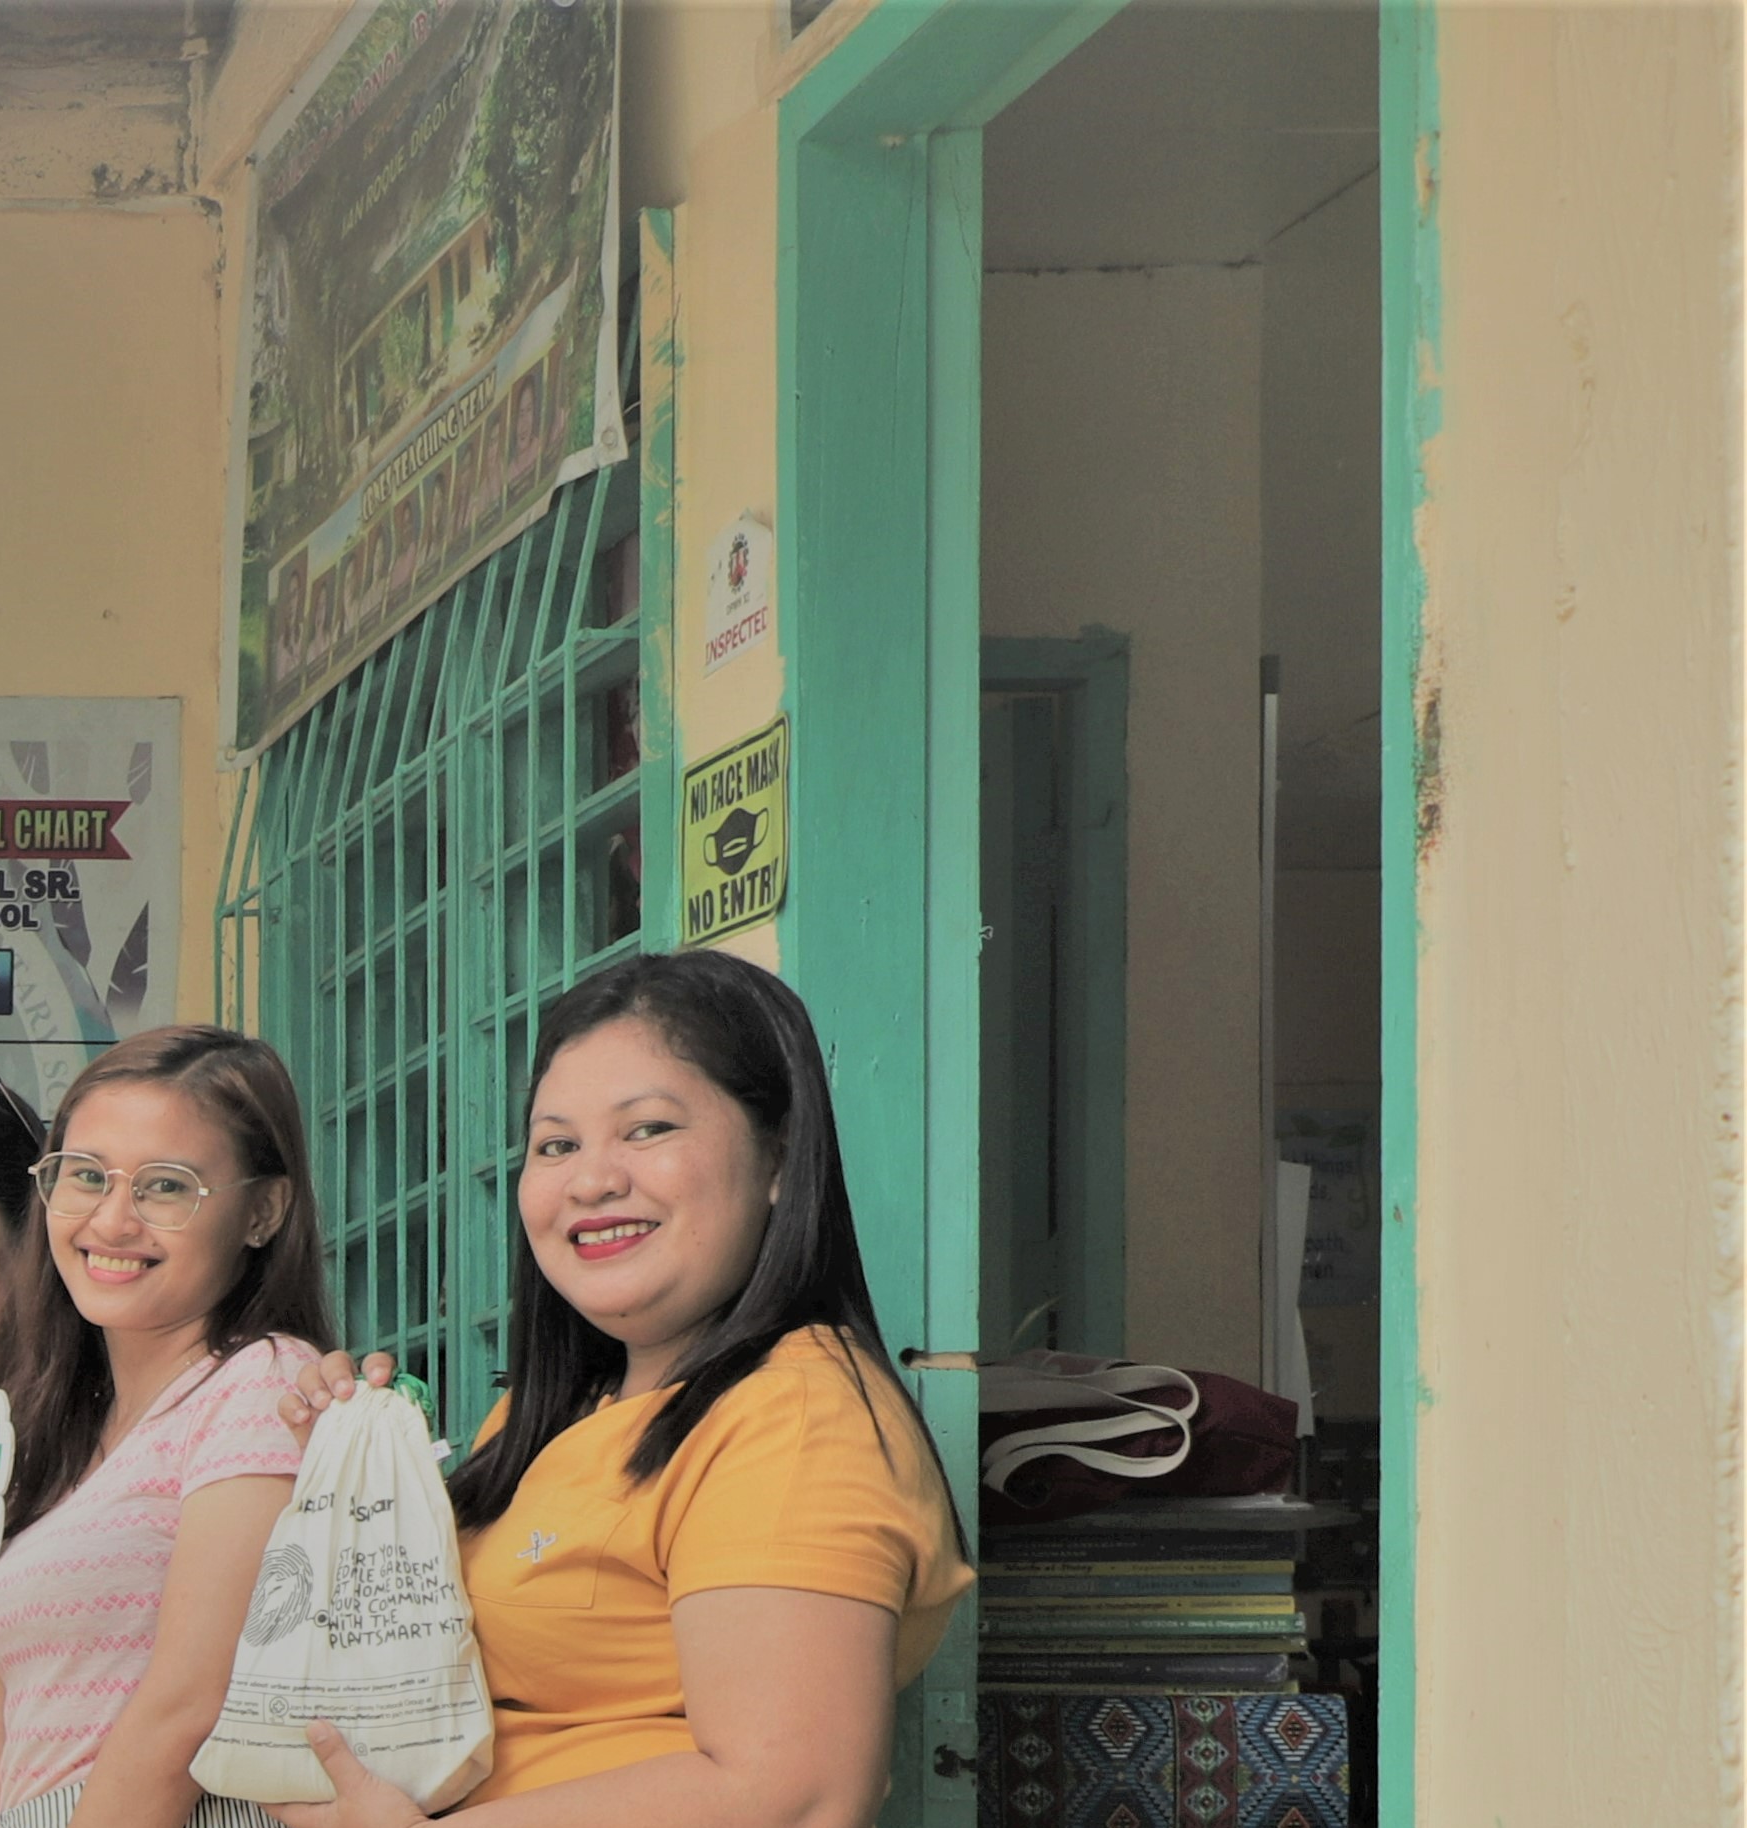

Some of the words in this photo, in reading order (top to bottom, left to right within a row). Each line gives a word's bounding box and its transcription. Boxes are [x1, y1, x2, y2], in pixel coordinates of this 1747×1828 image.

[690, 782, 707, 825] NO
[711, 766, 744, 815] FACE
[747, 735, 781, 797] MASK
[14, 808, 108, 850] CHART
[25, 870, 81, 899] SR.
[689, 892, 715, 938] NO
[719, 855, 778, 922] ENTRY
